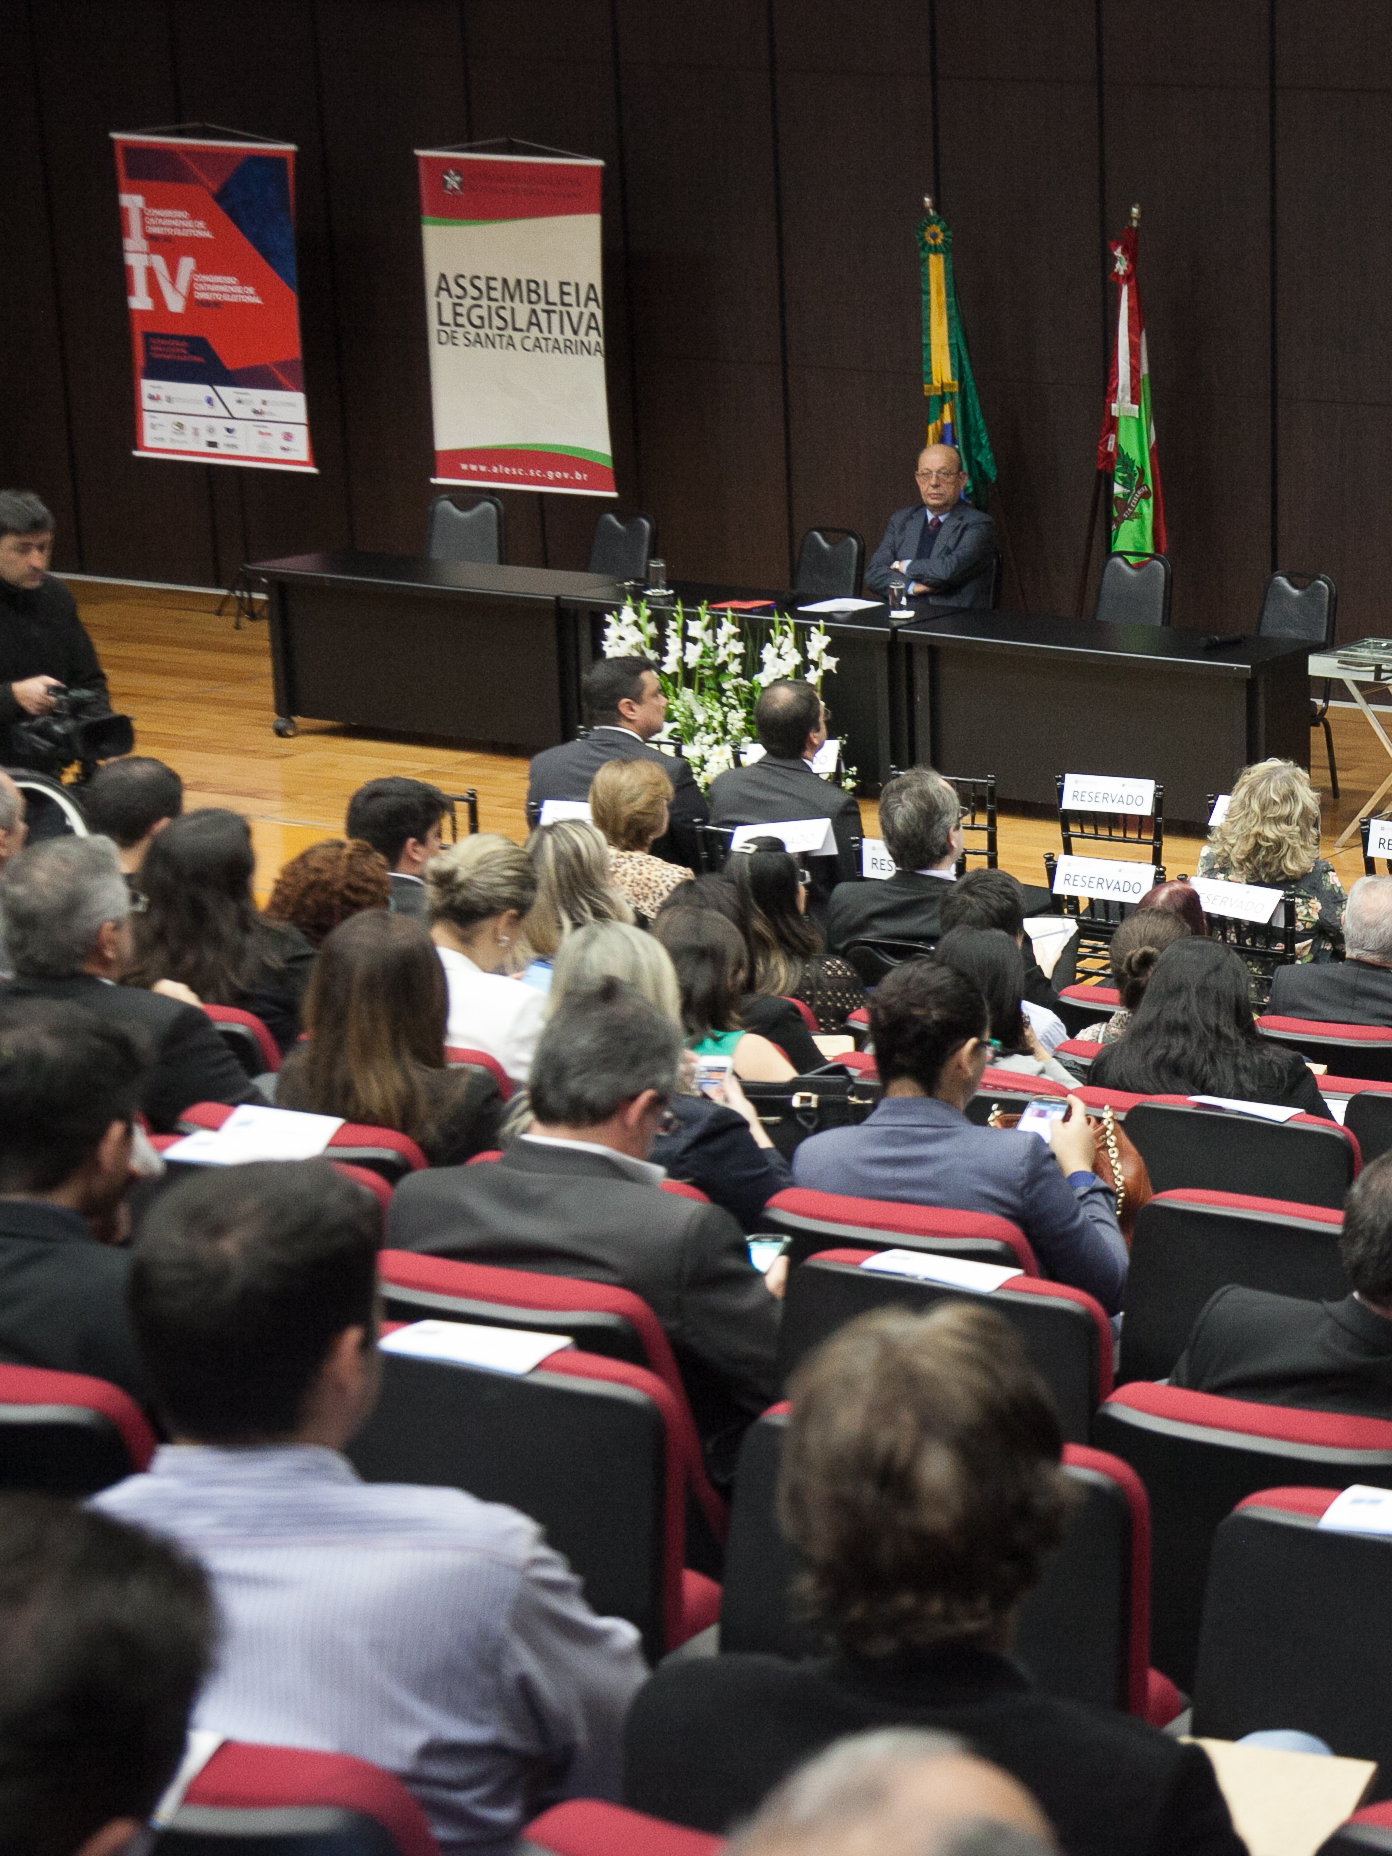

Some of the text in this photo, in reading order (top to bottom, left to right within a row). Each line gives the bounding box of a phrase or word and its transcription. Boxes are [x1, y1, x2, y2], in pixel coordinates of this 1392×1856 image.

[124, 253, 196, 313] IV
[435, 273, 601, 309] ASSEMBLEIA
[436, 301, 602, 338] LEGISLATIVA
[436, 329, 605, 358] DE SANTA CATARINA
[459, 463, 588, 481] www.alesc.sc.gov.br
[1072, 790, 1144, 806] RESERVADO
[1063, 873, 1142, 895] RESERVADO
